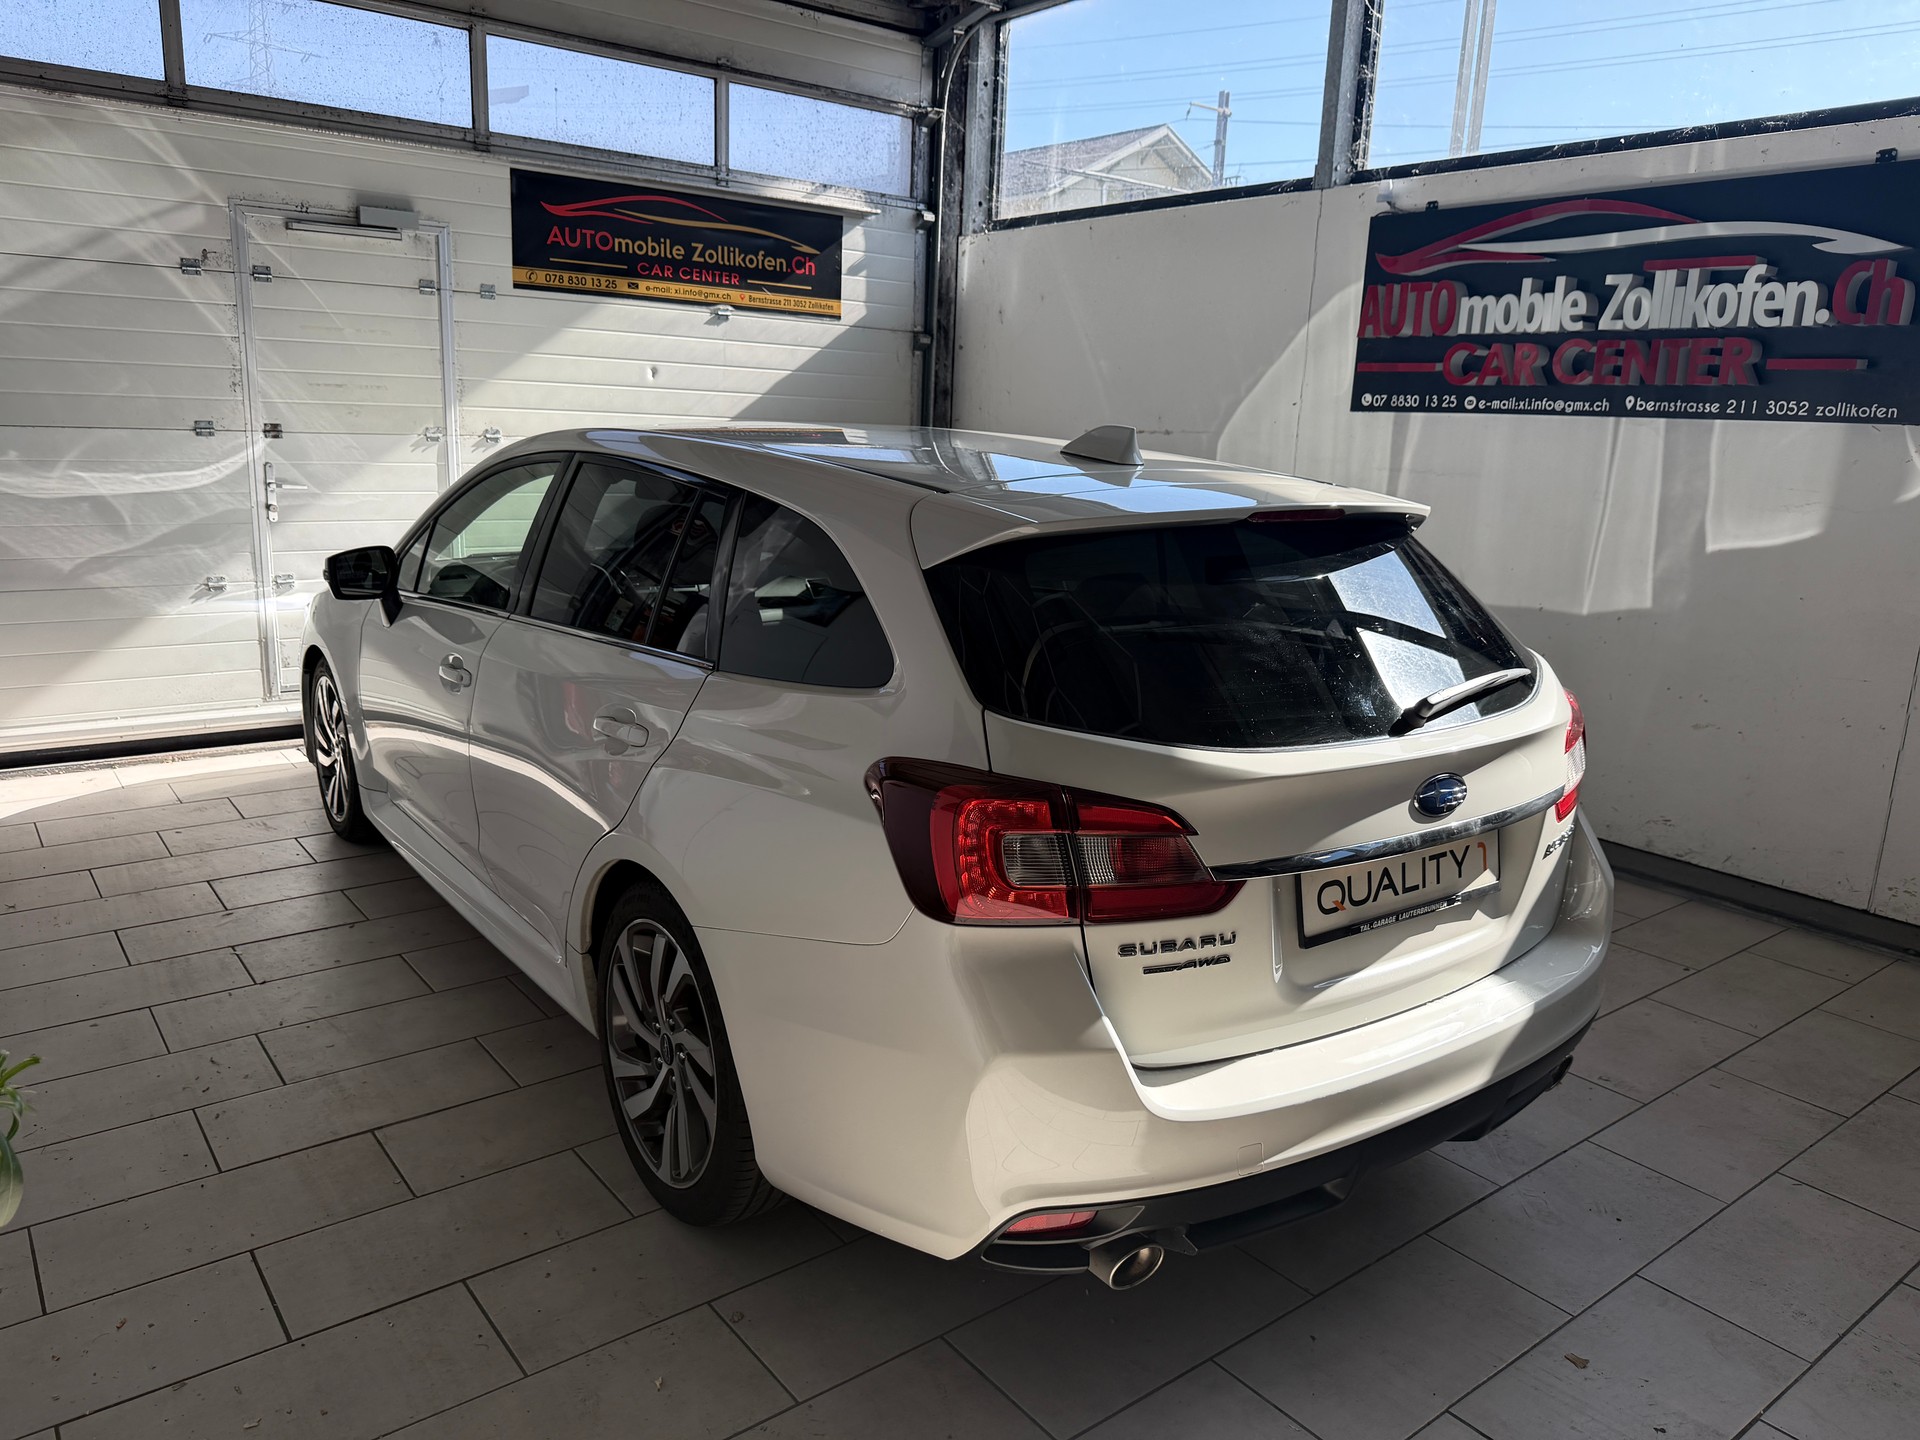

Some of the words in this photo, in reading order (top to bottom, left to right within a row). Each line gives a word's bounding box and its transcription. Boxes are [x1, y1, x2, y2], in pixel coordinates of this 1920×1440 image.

[546, 225, 685, 259] AUTOmobile
[691, 242, 816, 276] Zollikofen.Ch
[544, 272, 565, 284] 078
[567, 275, 587, 287] 830
[591, 277, 602, 288] 13
[605, 279, 618, 290] 25
[637, 262, 674, 278] CAR
[679, 266, 740, 285] CENTER
[748, 294, 782, 306] Bernstrasse
[783, 297, 792, 307] 211
[793, 299, 807, 308] 3052
[808, 301, 834, 311] Zollikofen
[1358, 275, 1592, 337] AUTOmobile
[1442, 341, 1542, 386] CAR
[1552, 337, 1758, 386] CENTER
[1373, 394, 1388, 407] 07
[1390, 394, 1420, 408] 8830
[1425, 394, 1439, 408] 13
[1441, 394, 1457, 408] 25
[1635, 397, 1720, 414] bernstrasse
[1726, 399, 1758, 415] 211
[1766, 400, 1809, 416] 3052
[1815, 402, 1898, 419] zollikofen
[1317, 845, 1470, 915] QUALITY
[1117, 931, 1237, 957] SUBARU
[1177, 954, 1231, 971] AWD
